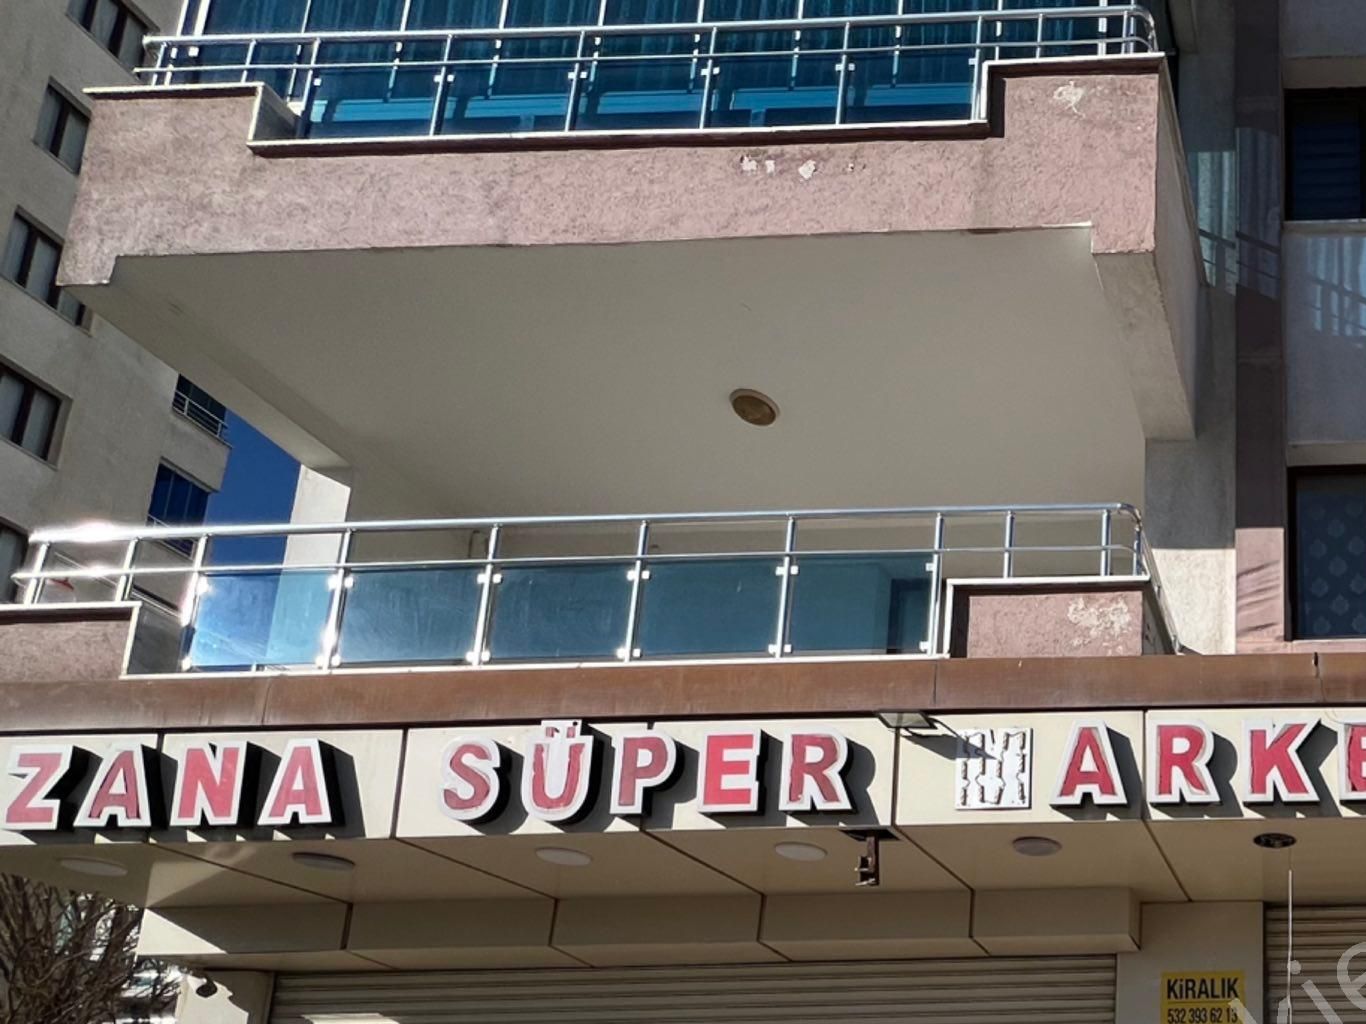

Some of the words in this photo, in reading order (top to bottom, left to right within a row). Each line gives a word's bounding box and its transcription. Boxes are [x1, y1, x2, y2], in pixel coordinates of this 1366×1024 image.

[4, 739, 334, 829] ZANA
[442, 719, 856, 824] SÜPER
[1167, 1008, 1186, 1024] 532
[1188, 1008, 1207, 1024] 393
[1210, 1008, 1223, 1024] 62
